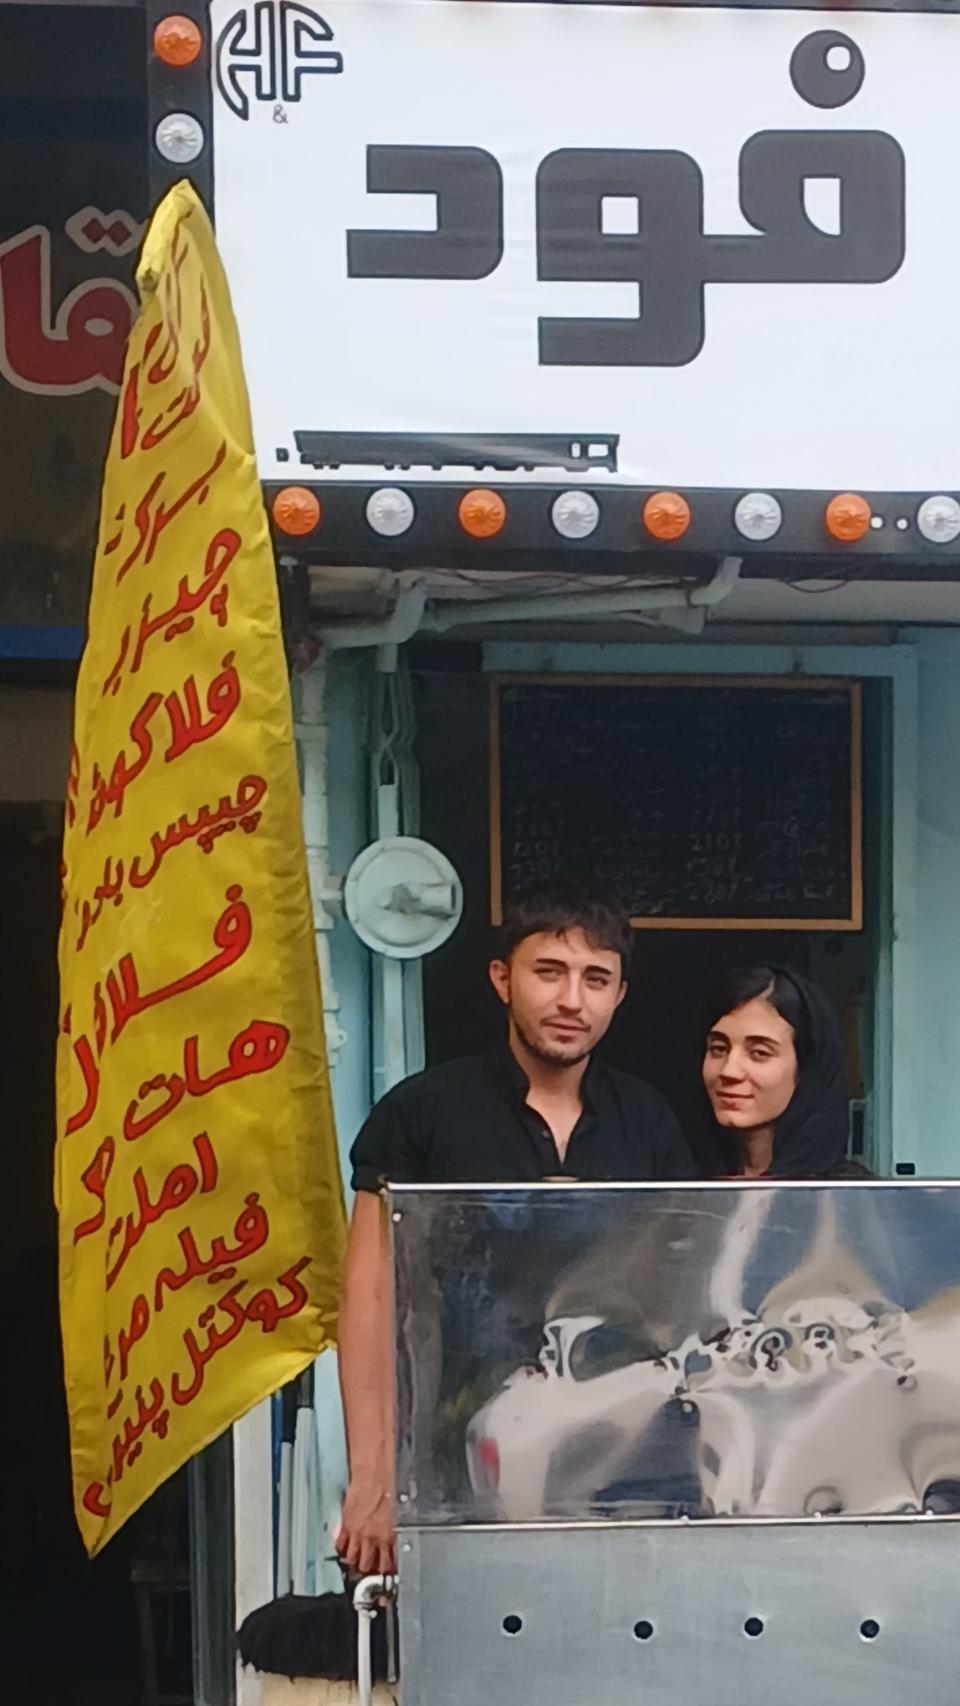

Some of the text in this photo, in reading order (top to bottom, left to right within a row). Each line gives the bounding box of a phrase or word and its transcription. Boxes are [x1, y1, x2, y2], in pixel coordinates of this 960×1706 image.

[346, 29, 905, 367] فود
[128, 774, 268, 889] چیپس
[123, 1019, 290, 1142] هات
[171, 1255, 314, 1407] کوکتل
